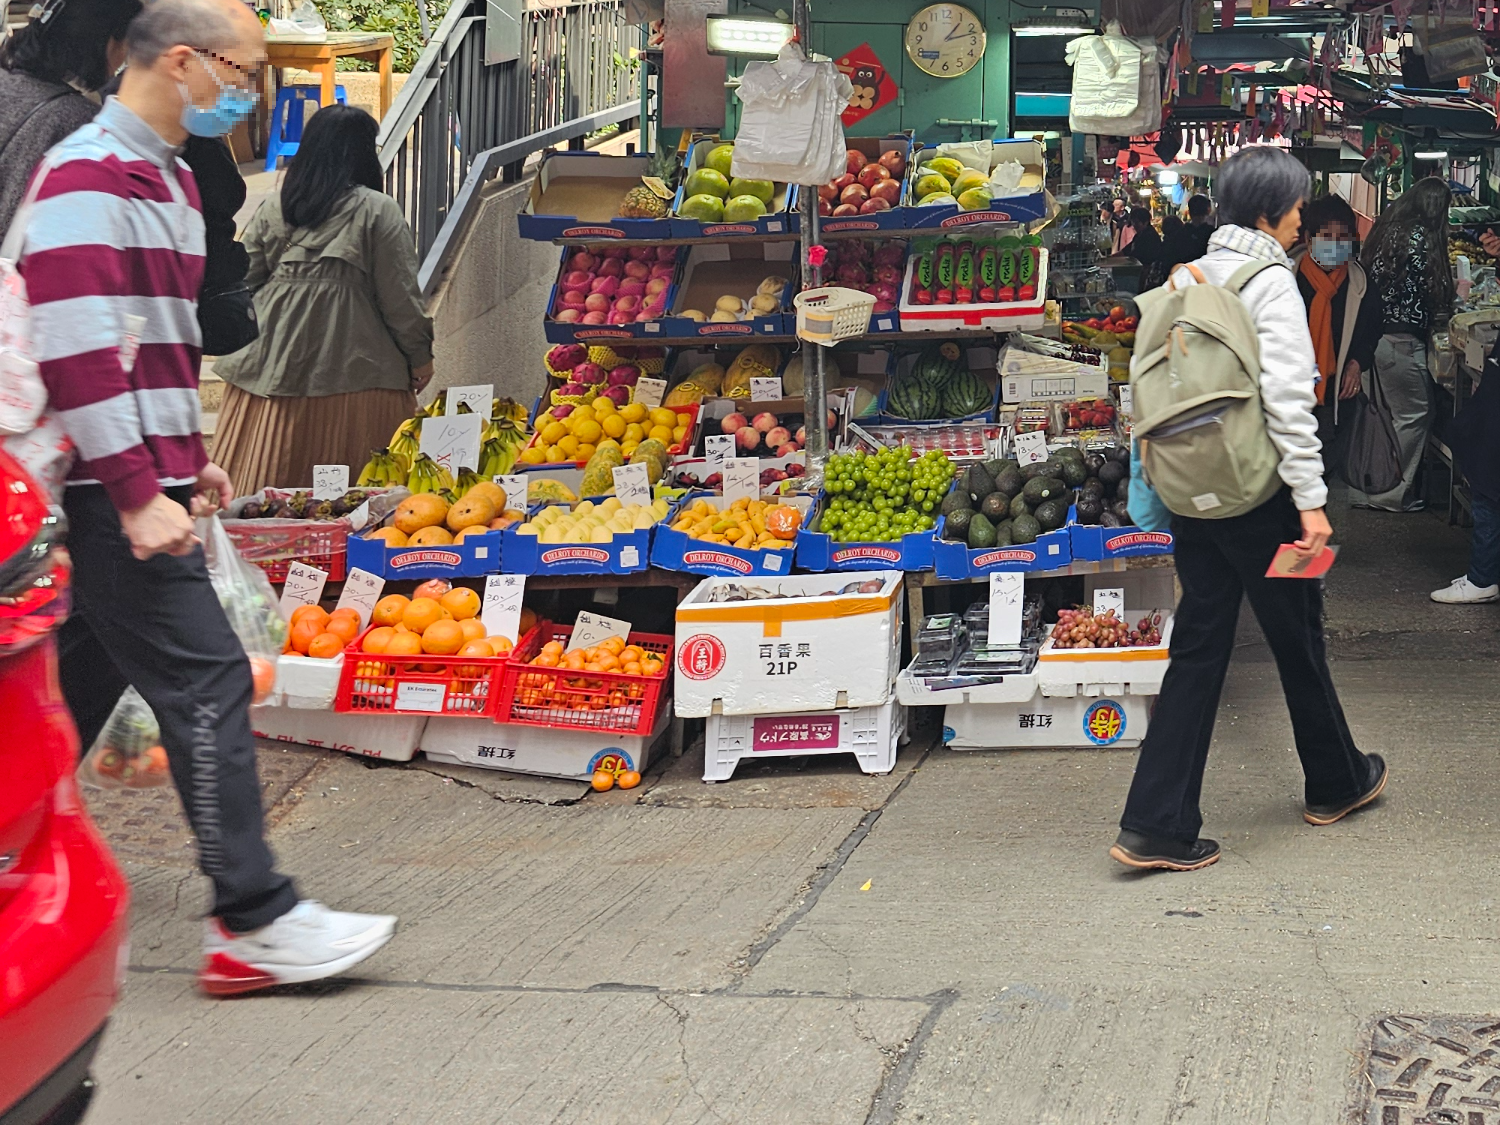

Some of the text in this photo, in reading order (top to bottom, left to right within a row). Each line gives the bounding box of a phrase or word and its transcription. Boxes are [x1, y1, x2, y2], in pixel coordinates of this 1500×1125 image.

[929, 13, 938, 22] 11
[942, 9, 952, 19] 12
[959, 13, 963, 22] 1
[918, 22, 928, 32] 10
[968, 22, 977, 33] 2
[915, 35, 922, 45] 9
[970, 36, 977, 45] 3
[967, 49, 974, 57] 4
[942, 62, 949, 71] 6
[956, 58, 963, 67] 5
[944, 214, 971, 227] DELROY
[971, 211, 1009, 222] ORCHARDS
[923, 257, 932, 286] rockit
[943, 257, 952, 287] rockit
[962, 256, 971, 285] rockit
[985, 258, 994, 287] rockit
[1003, 255, 1011, 281] rockit
[1022, 254, 1031, 283] rockit
[1108, 532, 1171, 549] DELROY ORCHARDS
[394, 551, 458, 565] DELROY ORCHARDS
[546, 548, 606, 561] DELROY ORCHARDS
[836, 547, 897, 560] DELROY ORCHARDS
[975, 550, 1035, 566] DELROY ORCHARDS
[689, 552, 749, 572] DELROY ORCHARDS
[758, 642, 812, 660] 百香果
[766, 661, 798, 676] 21P
[1018, 712, 1053, 729] 红提
[1089, 708, 1121, 738] 特
[477, 745, 517, 760] 红提
